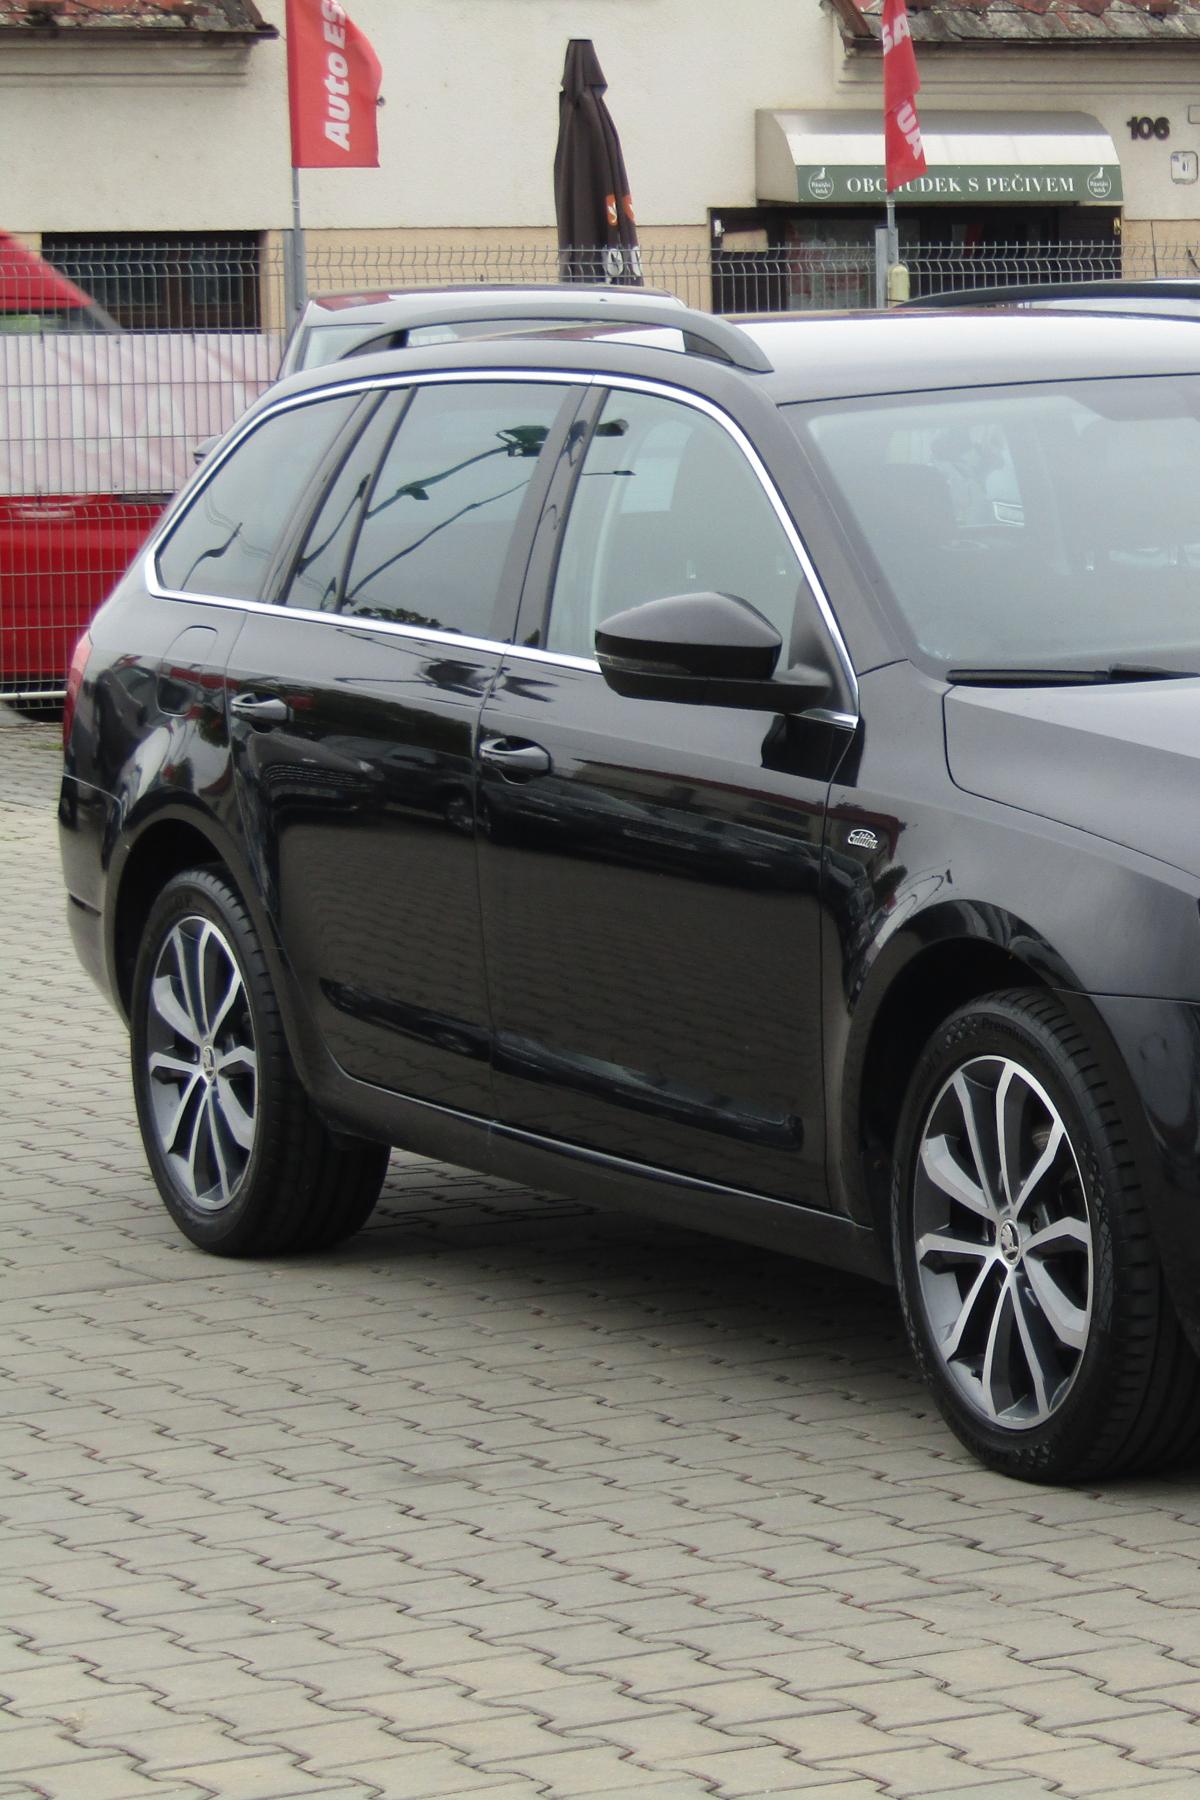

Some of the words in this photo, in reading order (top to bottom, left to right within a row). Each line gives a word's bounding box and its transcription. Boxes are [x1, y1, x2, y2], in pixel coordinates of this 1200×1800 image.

[324, 52, 350, 152] Auto
[1126, 116, 1170, 140] 106
[968, 176, 980, 193] S
[987, 173, 1075, 193] PEČIVEM
